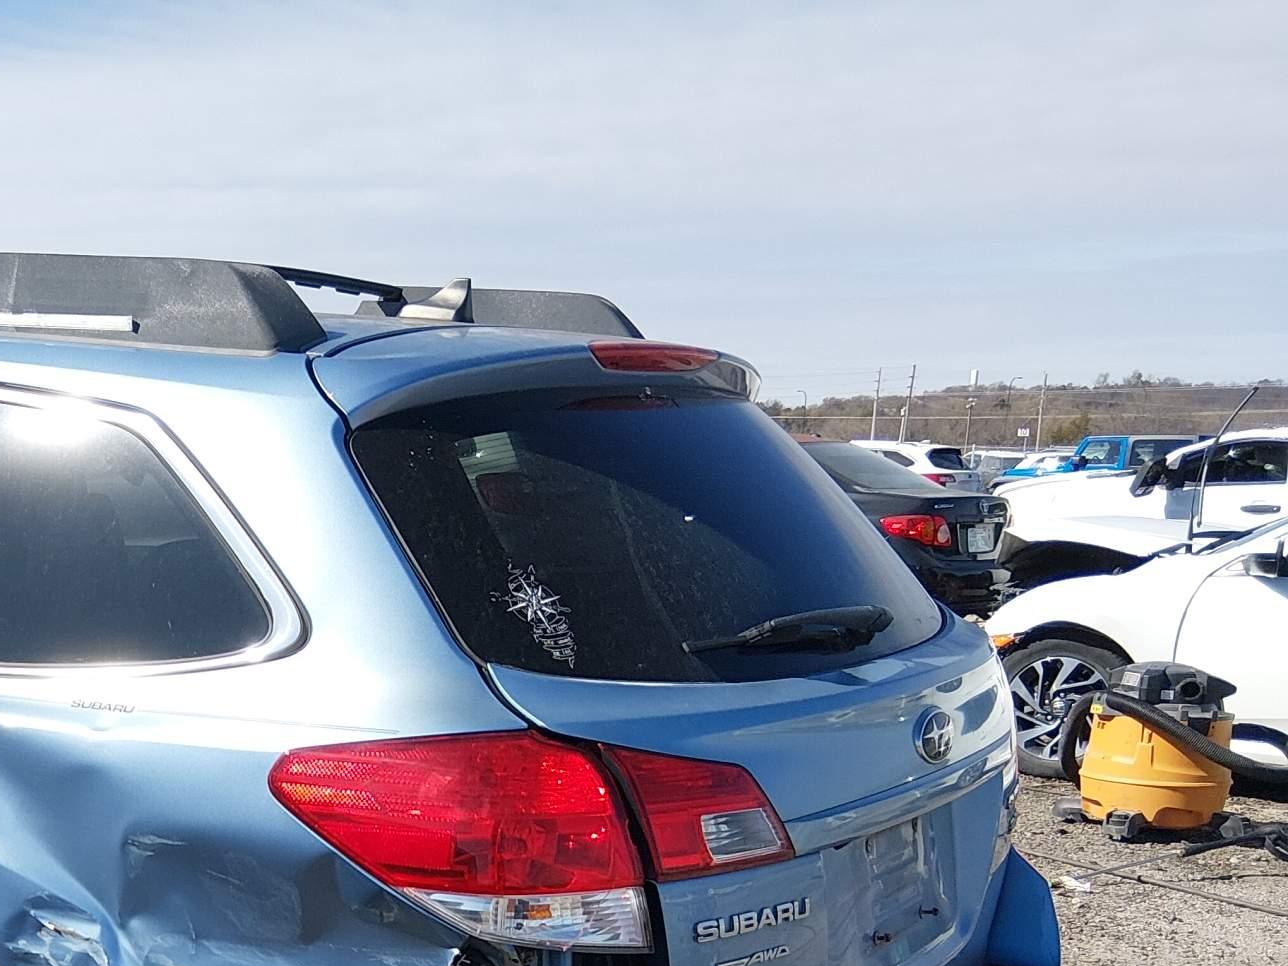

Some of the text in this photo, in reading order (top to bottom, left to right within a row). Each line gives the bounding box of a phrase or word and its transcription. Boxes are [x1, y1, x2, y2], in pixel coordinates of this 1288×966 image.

[71, 699, 135, 714] SUBARU
[695, 897, 811, 943] SUBARU
[748, 944, 790, 966] AWD
